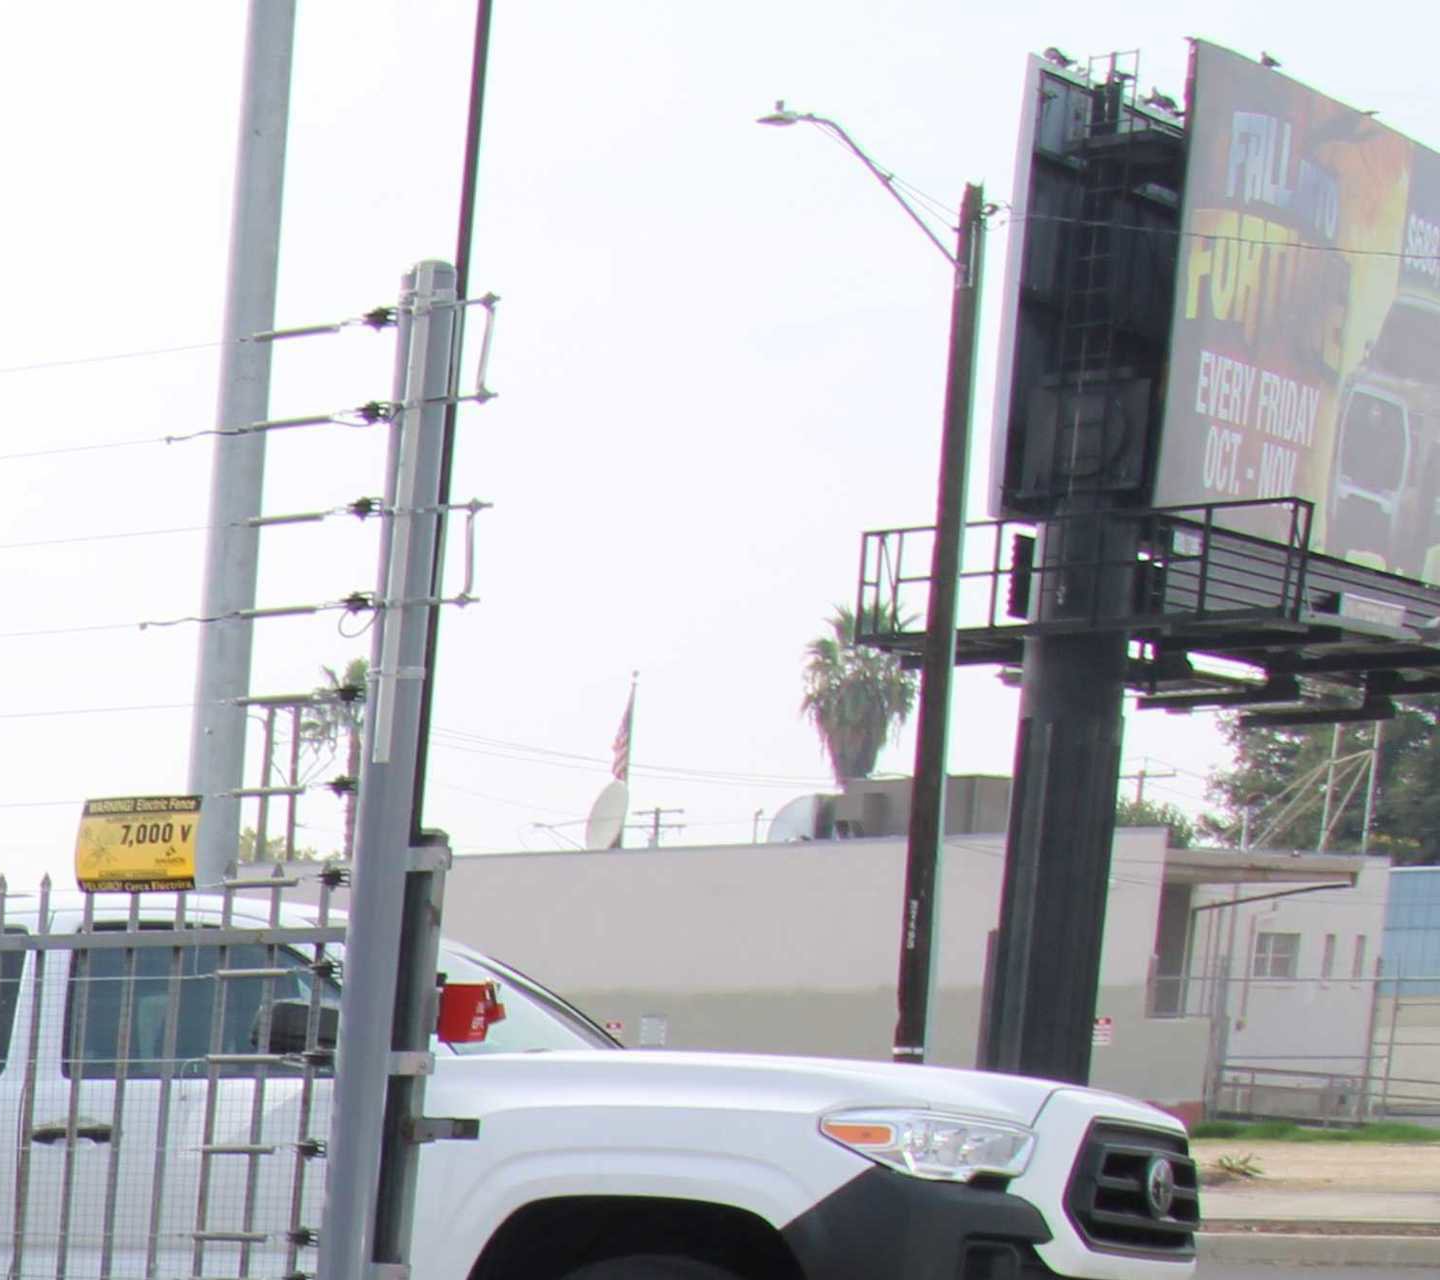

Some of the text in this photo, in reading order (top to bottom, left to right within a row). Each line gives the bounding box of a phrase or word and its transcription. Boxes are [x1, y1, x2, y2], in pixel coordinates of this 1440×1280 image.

[1195, 350, 1321, 447] EVERY FRIDAY
[121, 823, 193, 848] 7,000 V
